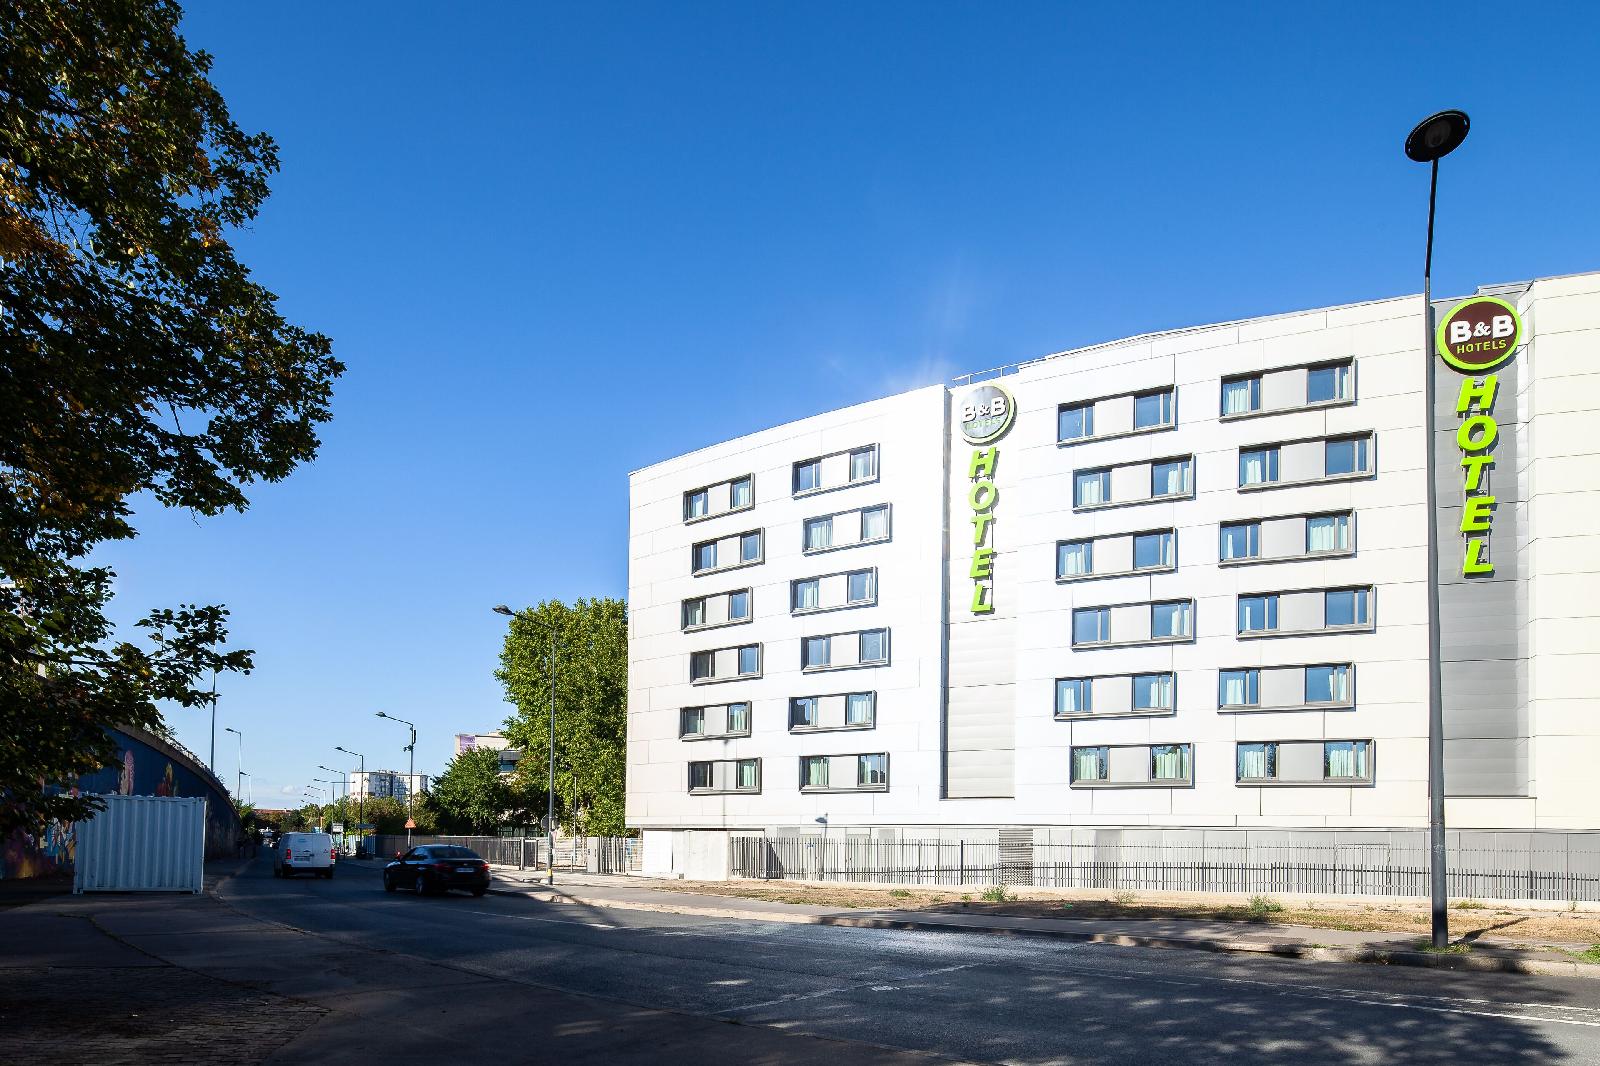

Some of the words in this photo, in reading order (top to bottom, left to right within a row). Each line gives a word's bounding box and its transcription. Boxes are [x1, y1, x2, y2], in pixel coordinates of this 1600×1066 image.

[1450, 315, 1514, 344] B&B
[1456, 339, 1507, 354] HOTELS
[962, 397, 1006, 423] B&B
[1456, 375, 1498, 574] HOTEL
[968, 447, 997, 612] HOTEL
